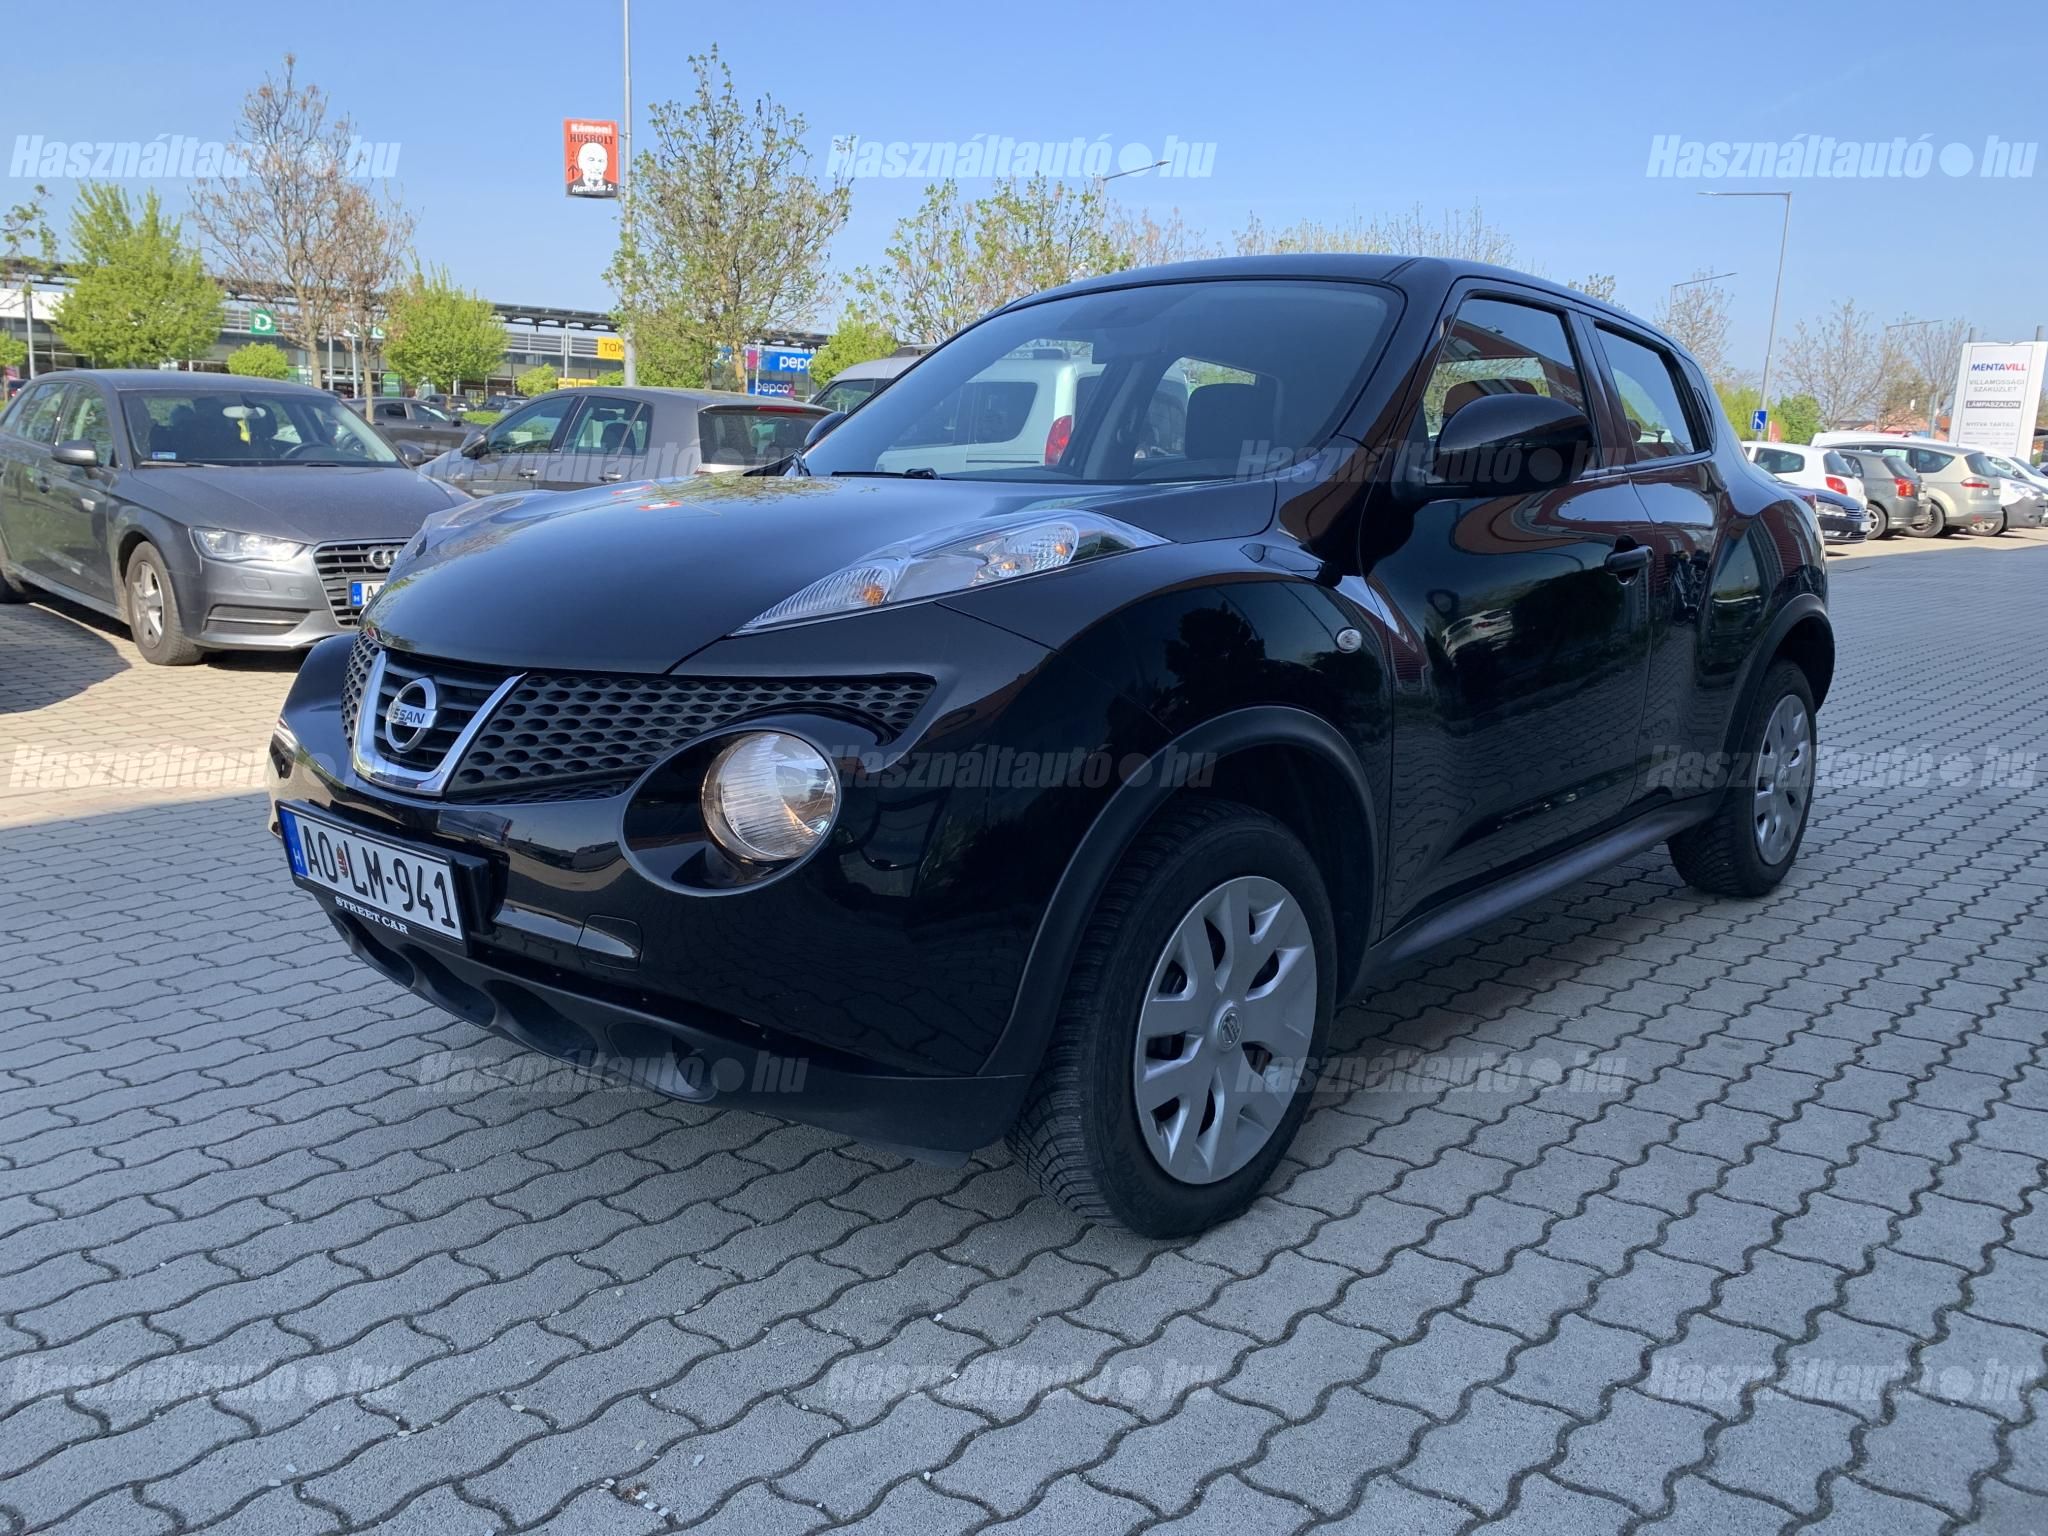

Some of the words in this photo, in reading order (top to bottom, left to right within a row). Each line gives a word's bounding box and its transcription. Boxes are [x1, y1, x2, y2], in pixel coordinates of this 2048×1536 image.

[1971, 363, 2026, 371] MENTAVILL
[292, 848, 301, 865] H
[335, 896, 380, 924] STREET
[380, 915, 409, 935] CAR
